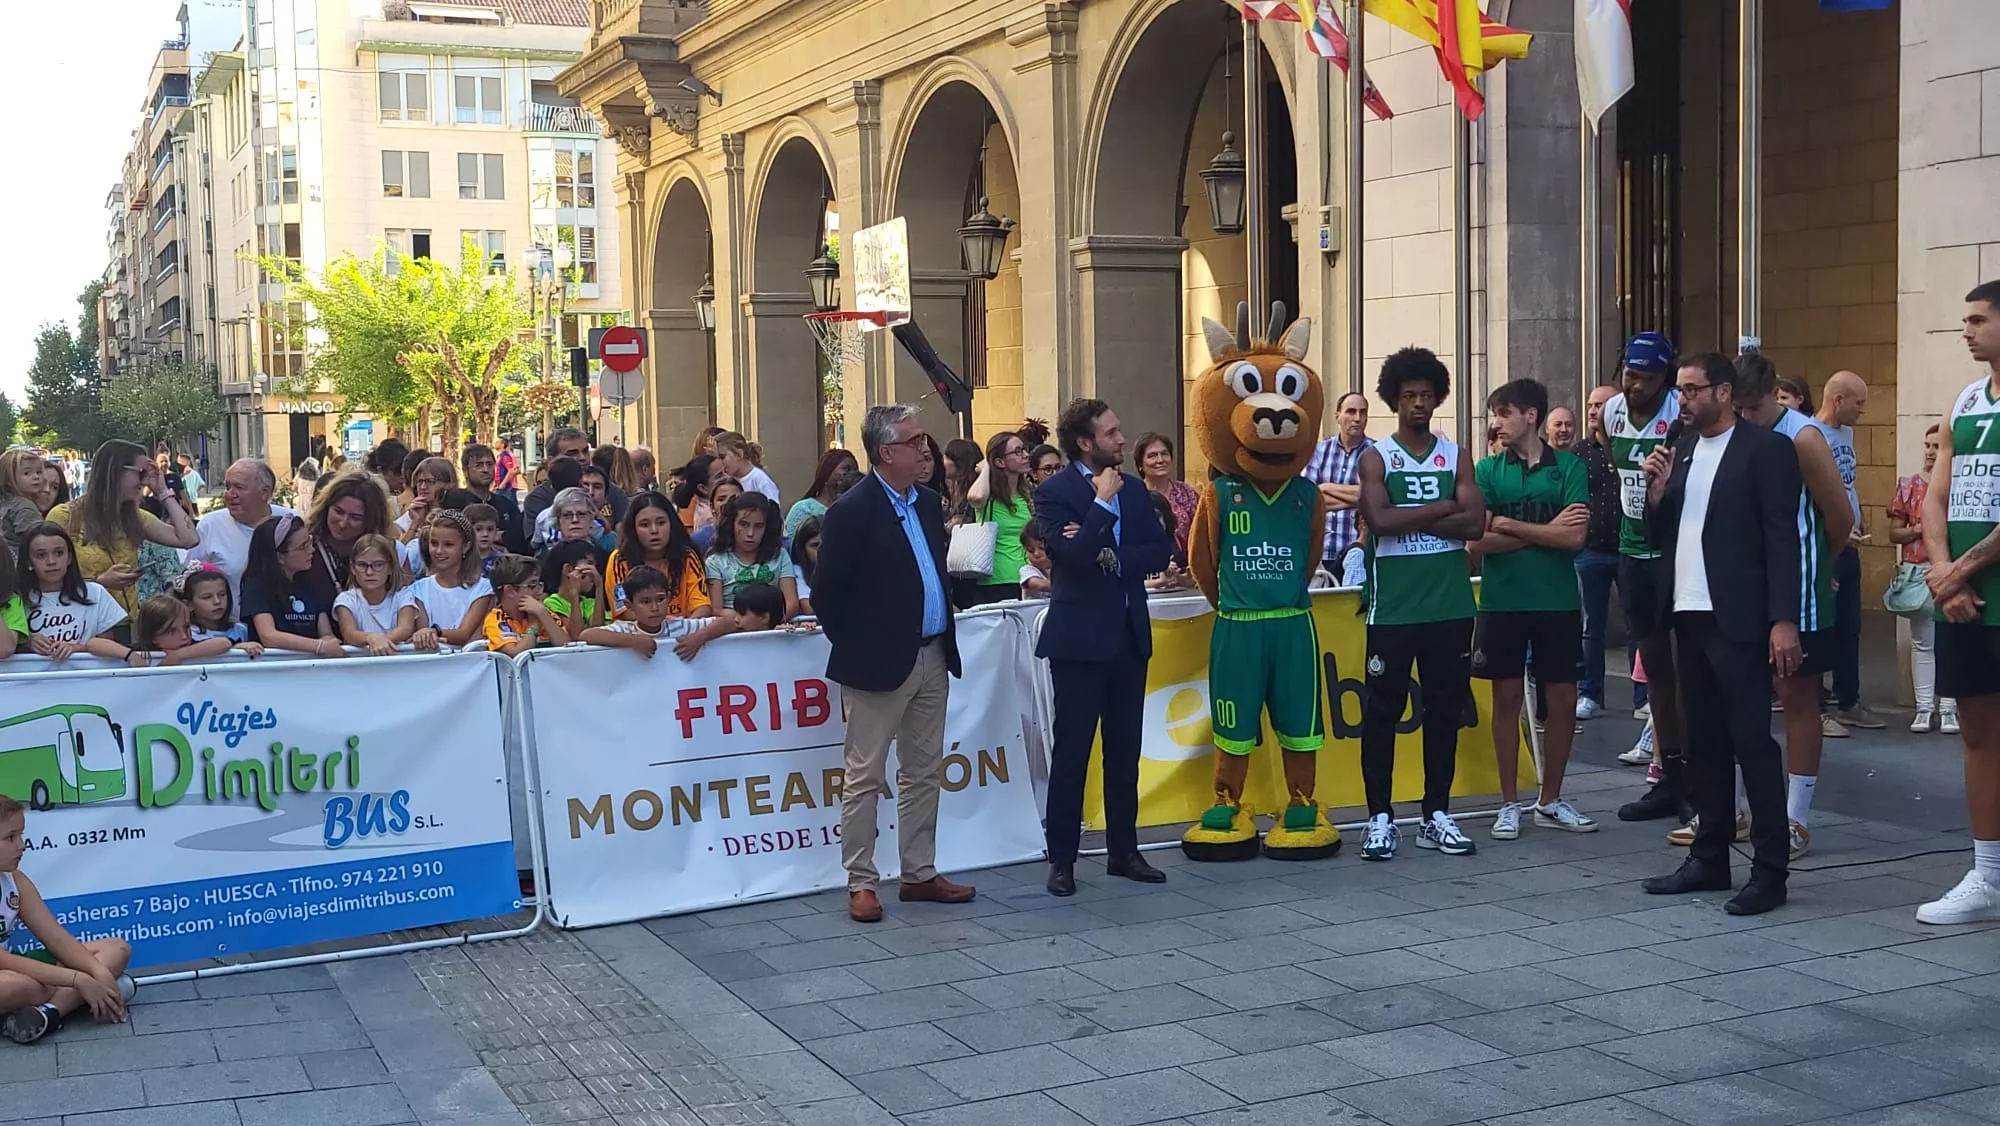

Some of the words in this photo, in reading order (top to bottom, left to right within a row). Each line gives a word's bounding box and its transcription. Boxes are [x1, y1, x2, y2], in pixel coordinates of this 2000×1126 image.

[279, 401, 334, 414] MANGO
[1975, 419, 1993, 448] 7
[1628, 444, 1645, 467] 4
[1404, 476, 1440, 500] 33
[1229, 511, 1251, 535] 00
[1232, 541, 1292, 557] Lobe
[1233, 558, 1294, 572] Huesca
[28, 610, 75, 633] Ciao
[675, 678, 847, 739] FRIB
[1216, 699, 1237, 729] 00
[177, 701, 277, 748] Viajes
[135, 723, 360, 811] Dimitri
[567, 742, 1010, 839] MONTEARÓN
[324, 789, 410, 848] BUS
[414, 814, 444, 829] S.L.
[68, 830, 108, 847] 0332
[113, 826, 146, 841] Mm
[722, 828, 813, 857] DESDE
[56, 903, 129, 926] asheras
[134, 899, 144, 915] 7
[150, 896, 190, 915] Bajo
[204, 881, 278, 906] HUESCA
[288, 876, 339, 894] Tlfno.
[341, 870, 374, 888] 974
[377, 865, 407, 883] 221
[411, 860, 444, 878] 910
[228, 883, 455, 928] info@viajesdimitribus.com
